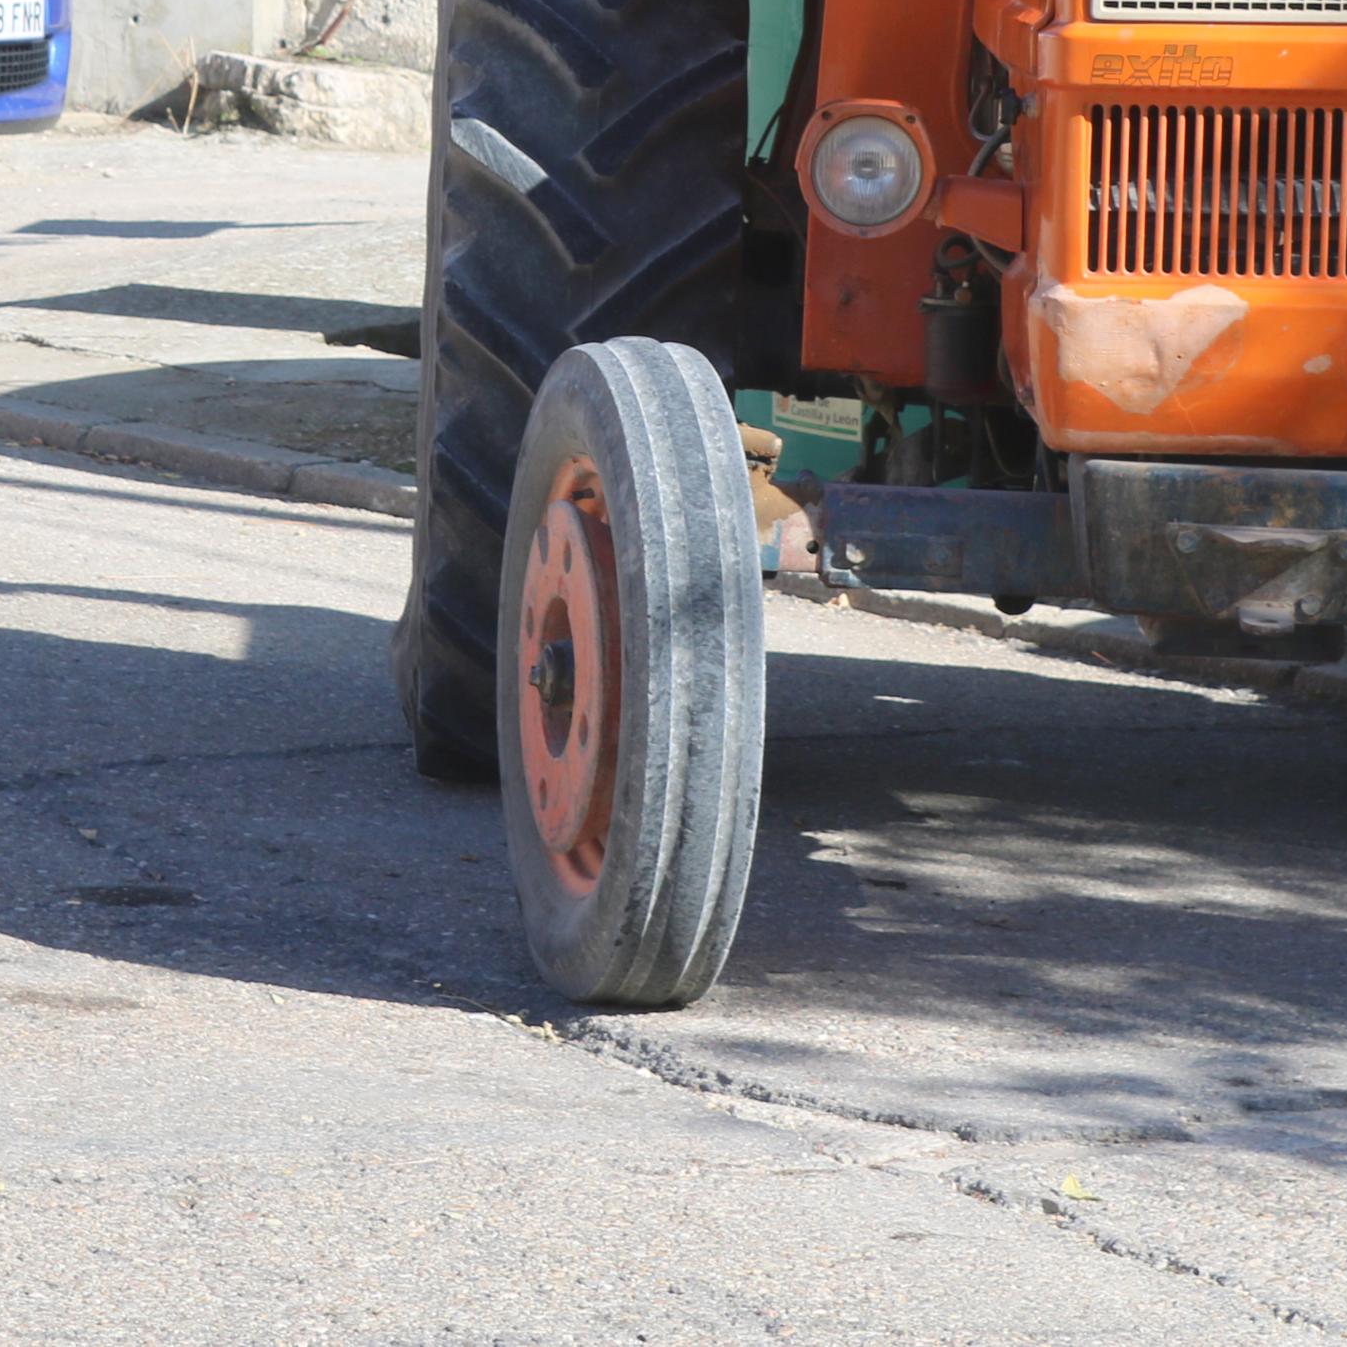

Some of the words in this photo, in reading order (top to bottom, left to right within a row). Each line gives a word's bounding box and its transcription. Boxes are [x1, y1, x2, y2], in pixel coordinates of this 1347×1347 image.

[12, 0, 42, 33] FNR
[1091, 43, 1234, 86] exito
[833, 413, 859, 427] León
